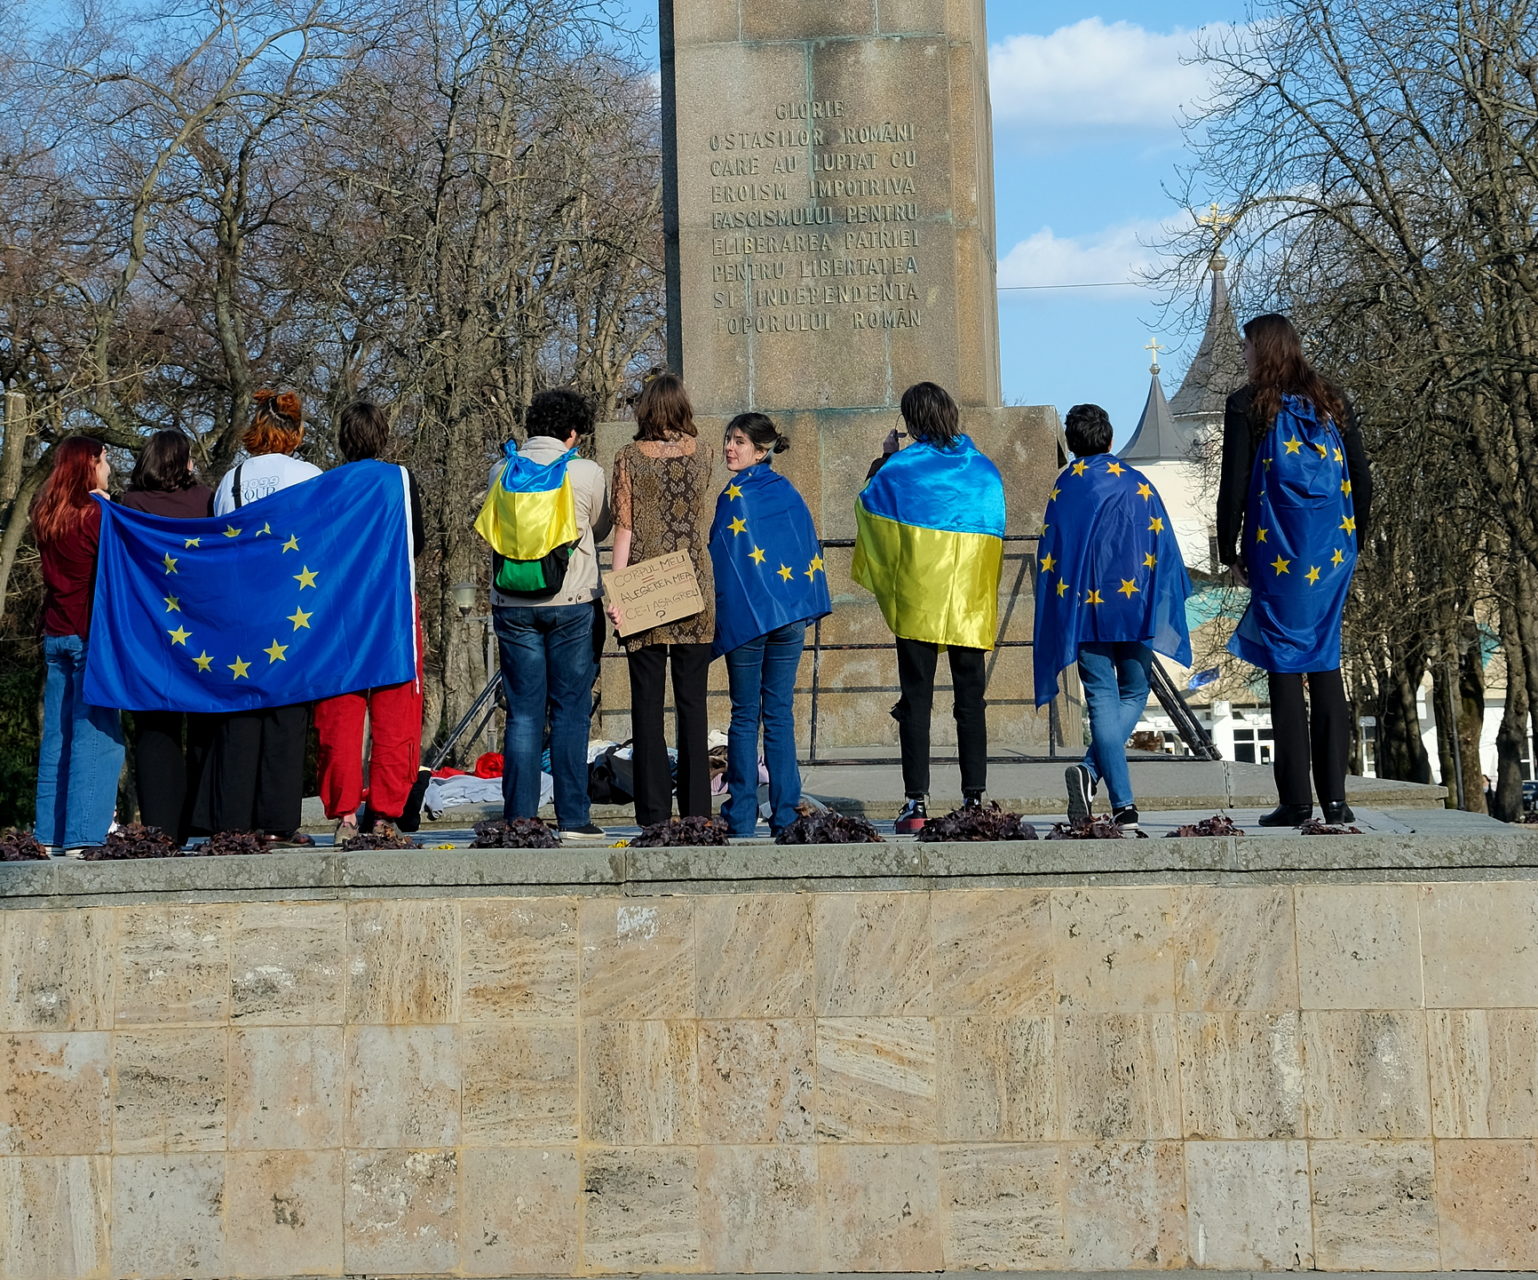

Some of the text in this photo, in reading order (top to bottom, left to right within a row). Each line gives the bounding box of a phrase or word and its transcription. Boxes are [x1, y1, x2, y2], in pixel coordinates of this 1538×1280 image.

[776, 100, 845, 120] GLORIE
[710, 150, 917, 177] CARE AU LUPTAT CU
[711, 177, 916, 203] EROISM IMPOTRIVA
[712, 204, 917, 229] FASCISMULUI PENTRU
[712, 229, 919, 256] ELIBERAREA PATRIEI
[713, 257, 918, 282] PENTRU LIBERTATEA
[614, 555, 685, 588] CORPUL MEU
[621, 571, 695, 604] ALEGEREA MEA
[672, 588, 699, 602] GREU
